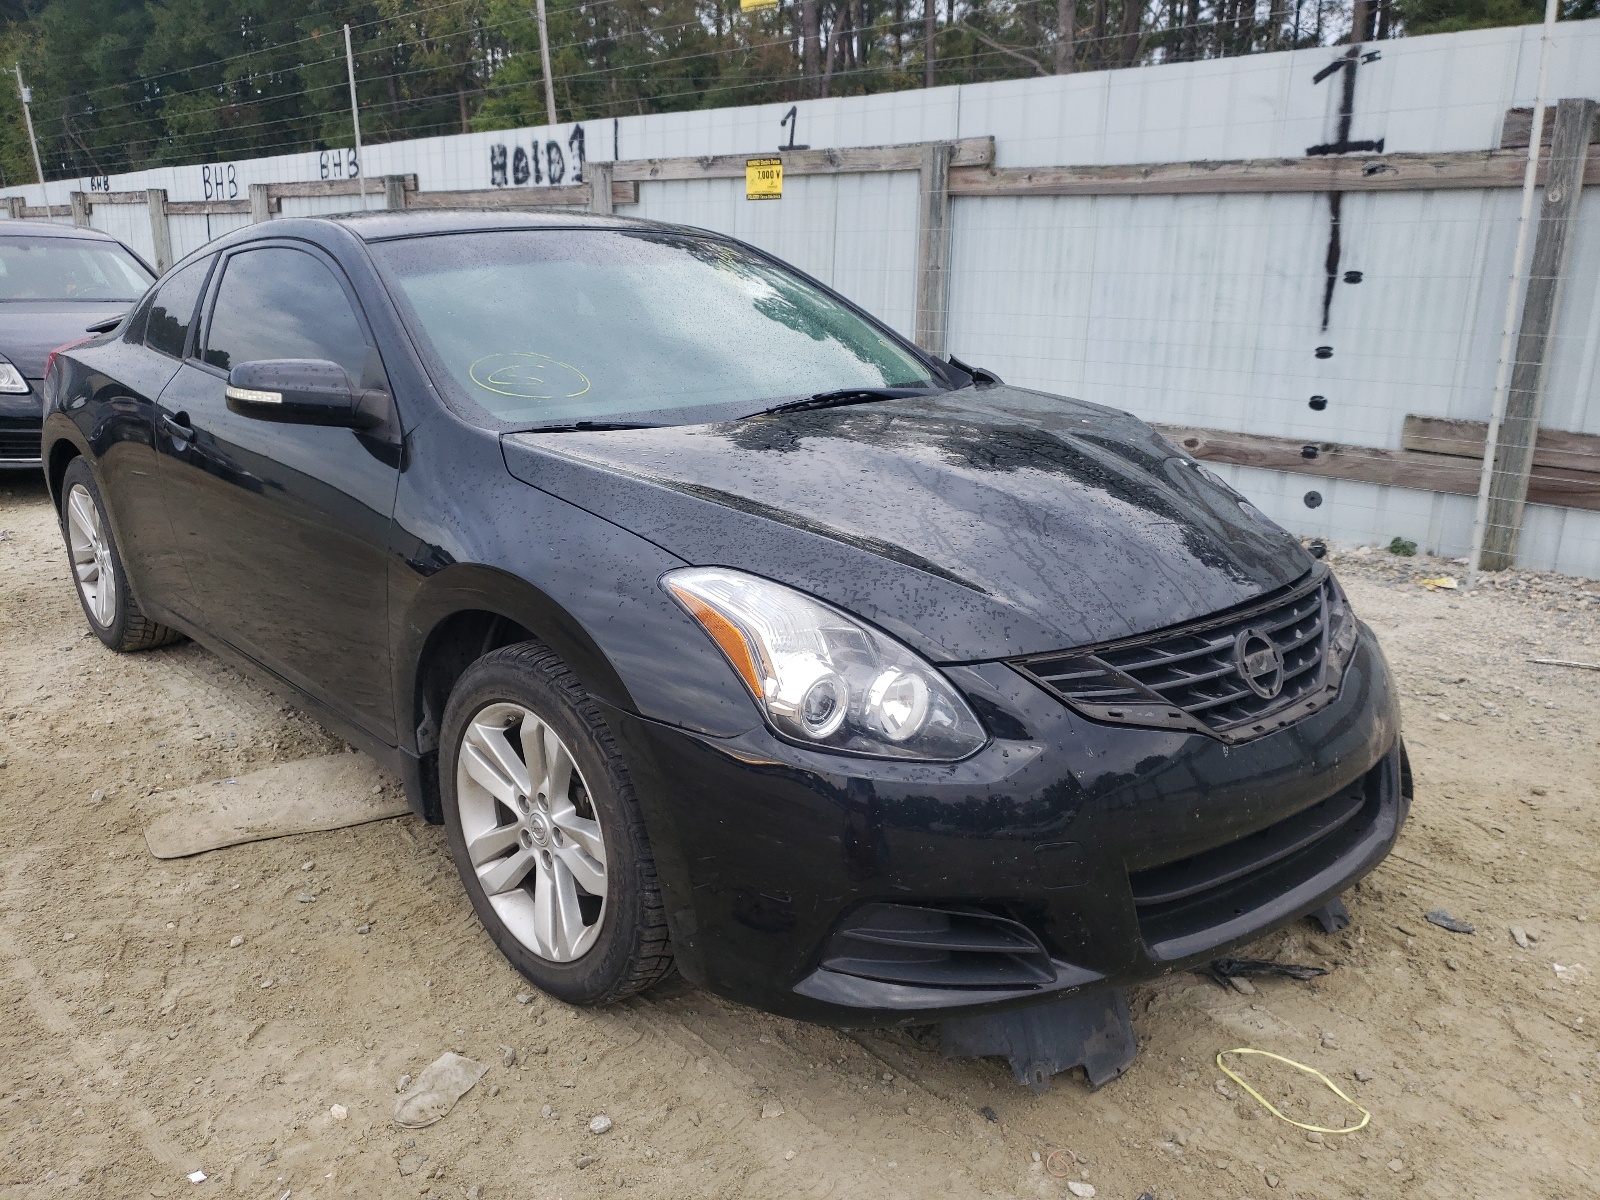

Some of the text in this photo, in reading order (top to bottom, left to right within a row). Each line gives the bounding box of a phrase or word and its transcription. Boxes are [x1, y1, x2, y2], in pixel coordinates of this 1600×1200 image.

[778, 105, 811, 152] 1
[320, 148, 360, 179] BHB
[203, 164, 238, 201] BHB
